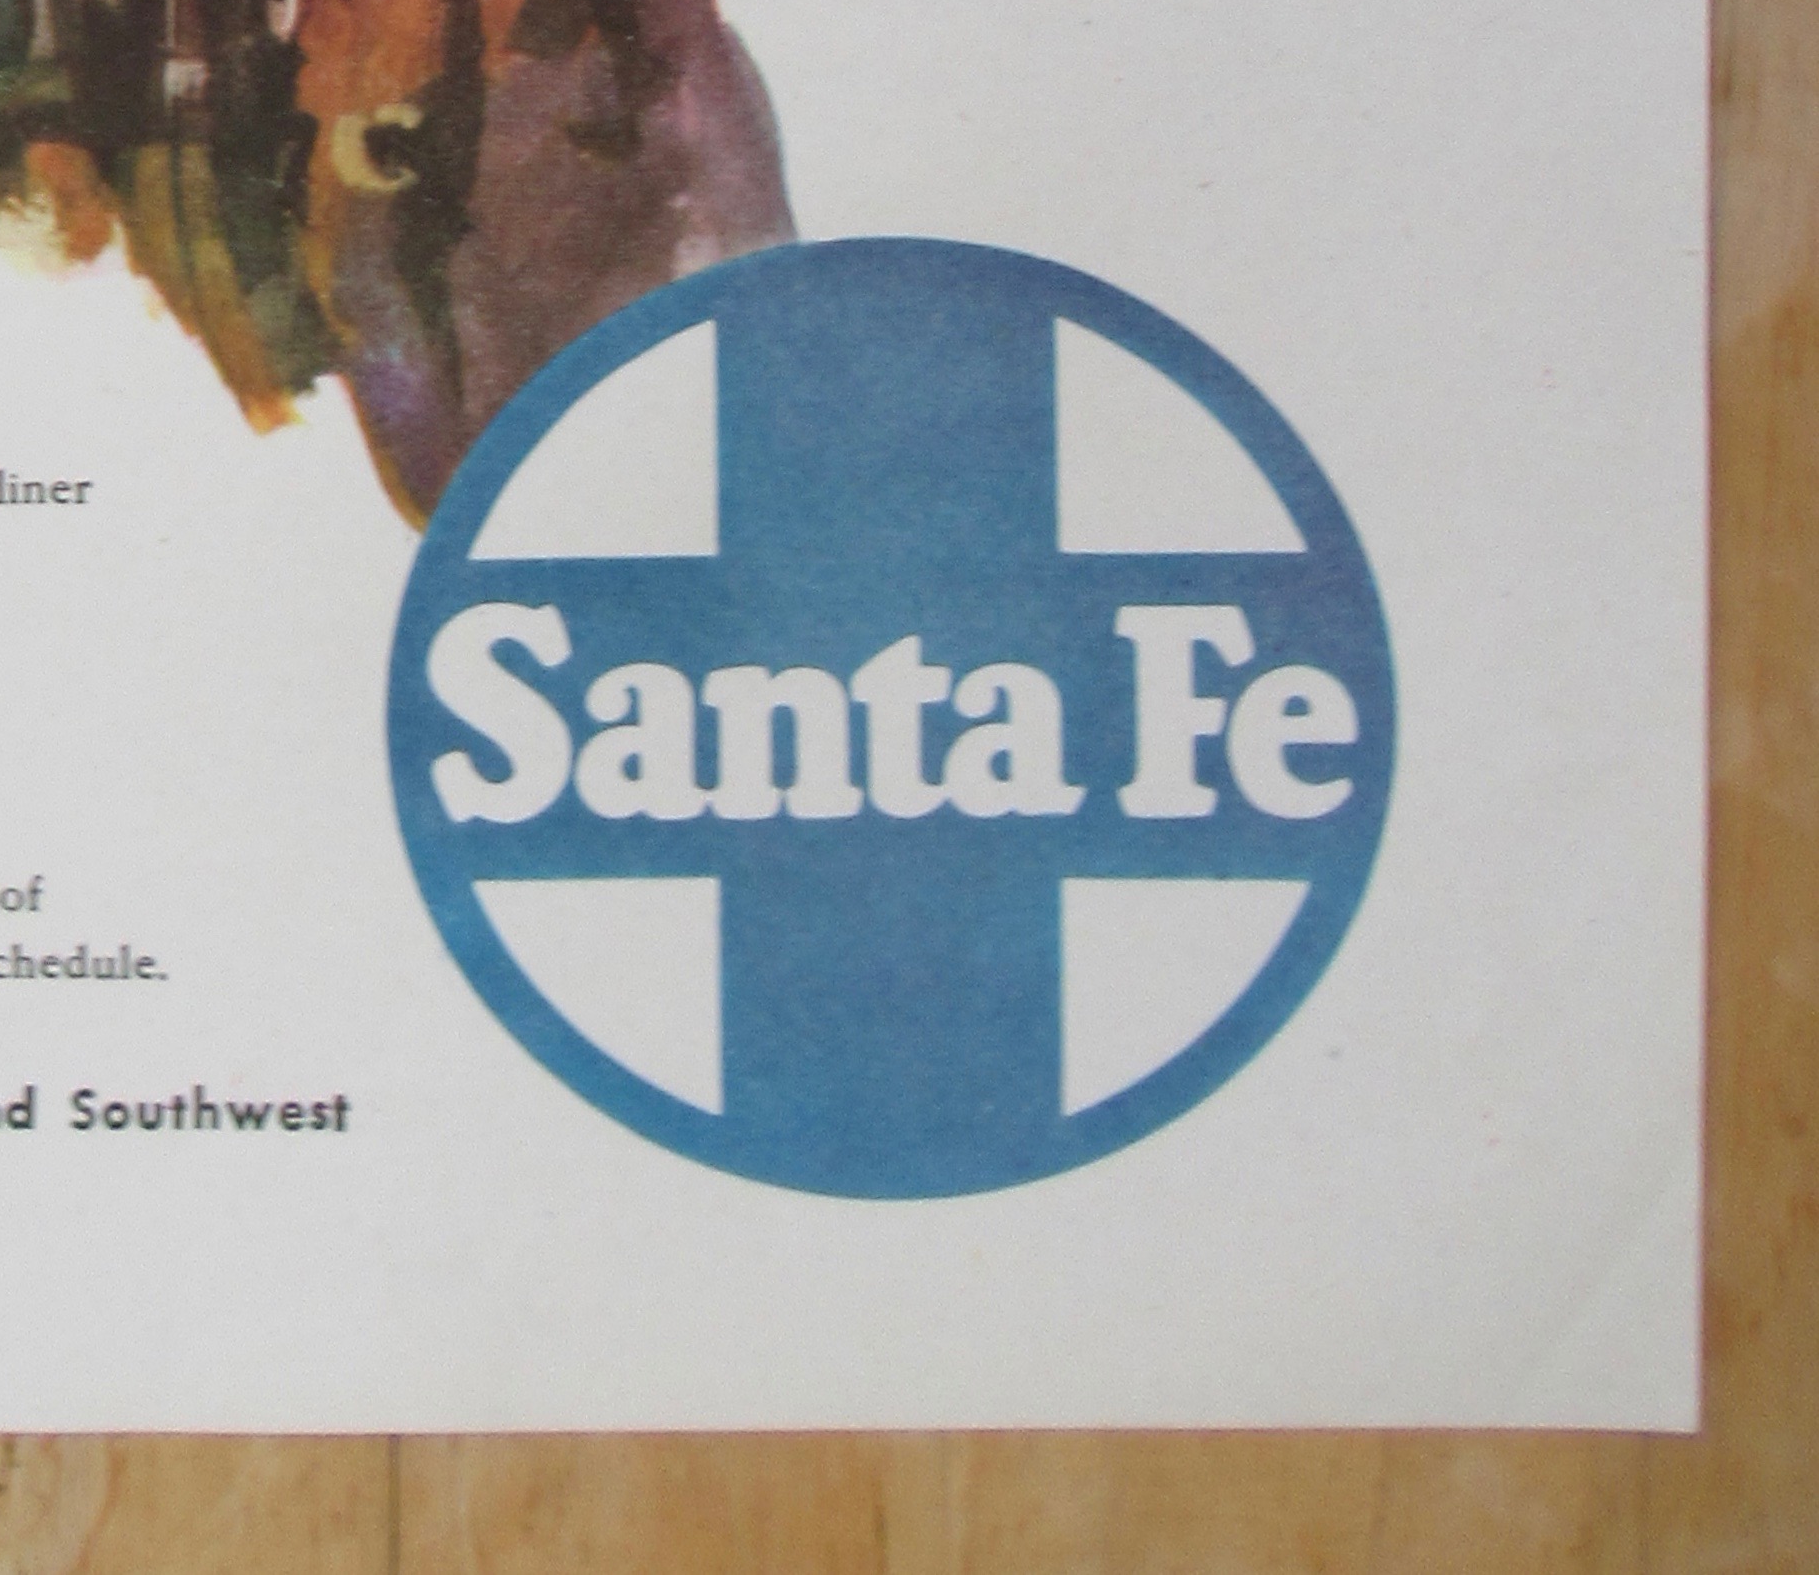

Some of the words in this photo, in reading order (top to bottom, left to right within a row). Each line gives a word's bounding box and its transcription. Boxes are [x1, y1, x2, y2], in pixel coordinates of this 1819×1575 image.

[426, 602, 1086, 824] Santa
[1115, 605, 1357, 819] Fe
[70, 1085, 353, 1133] Southwest
